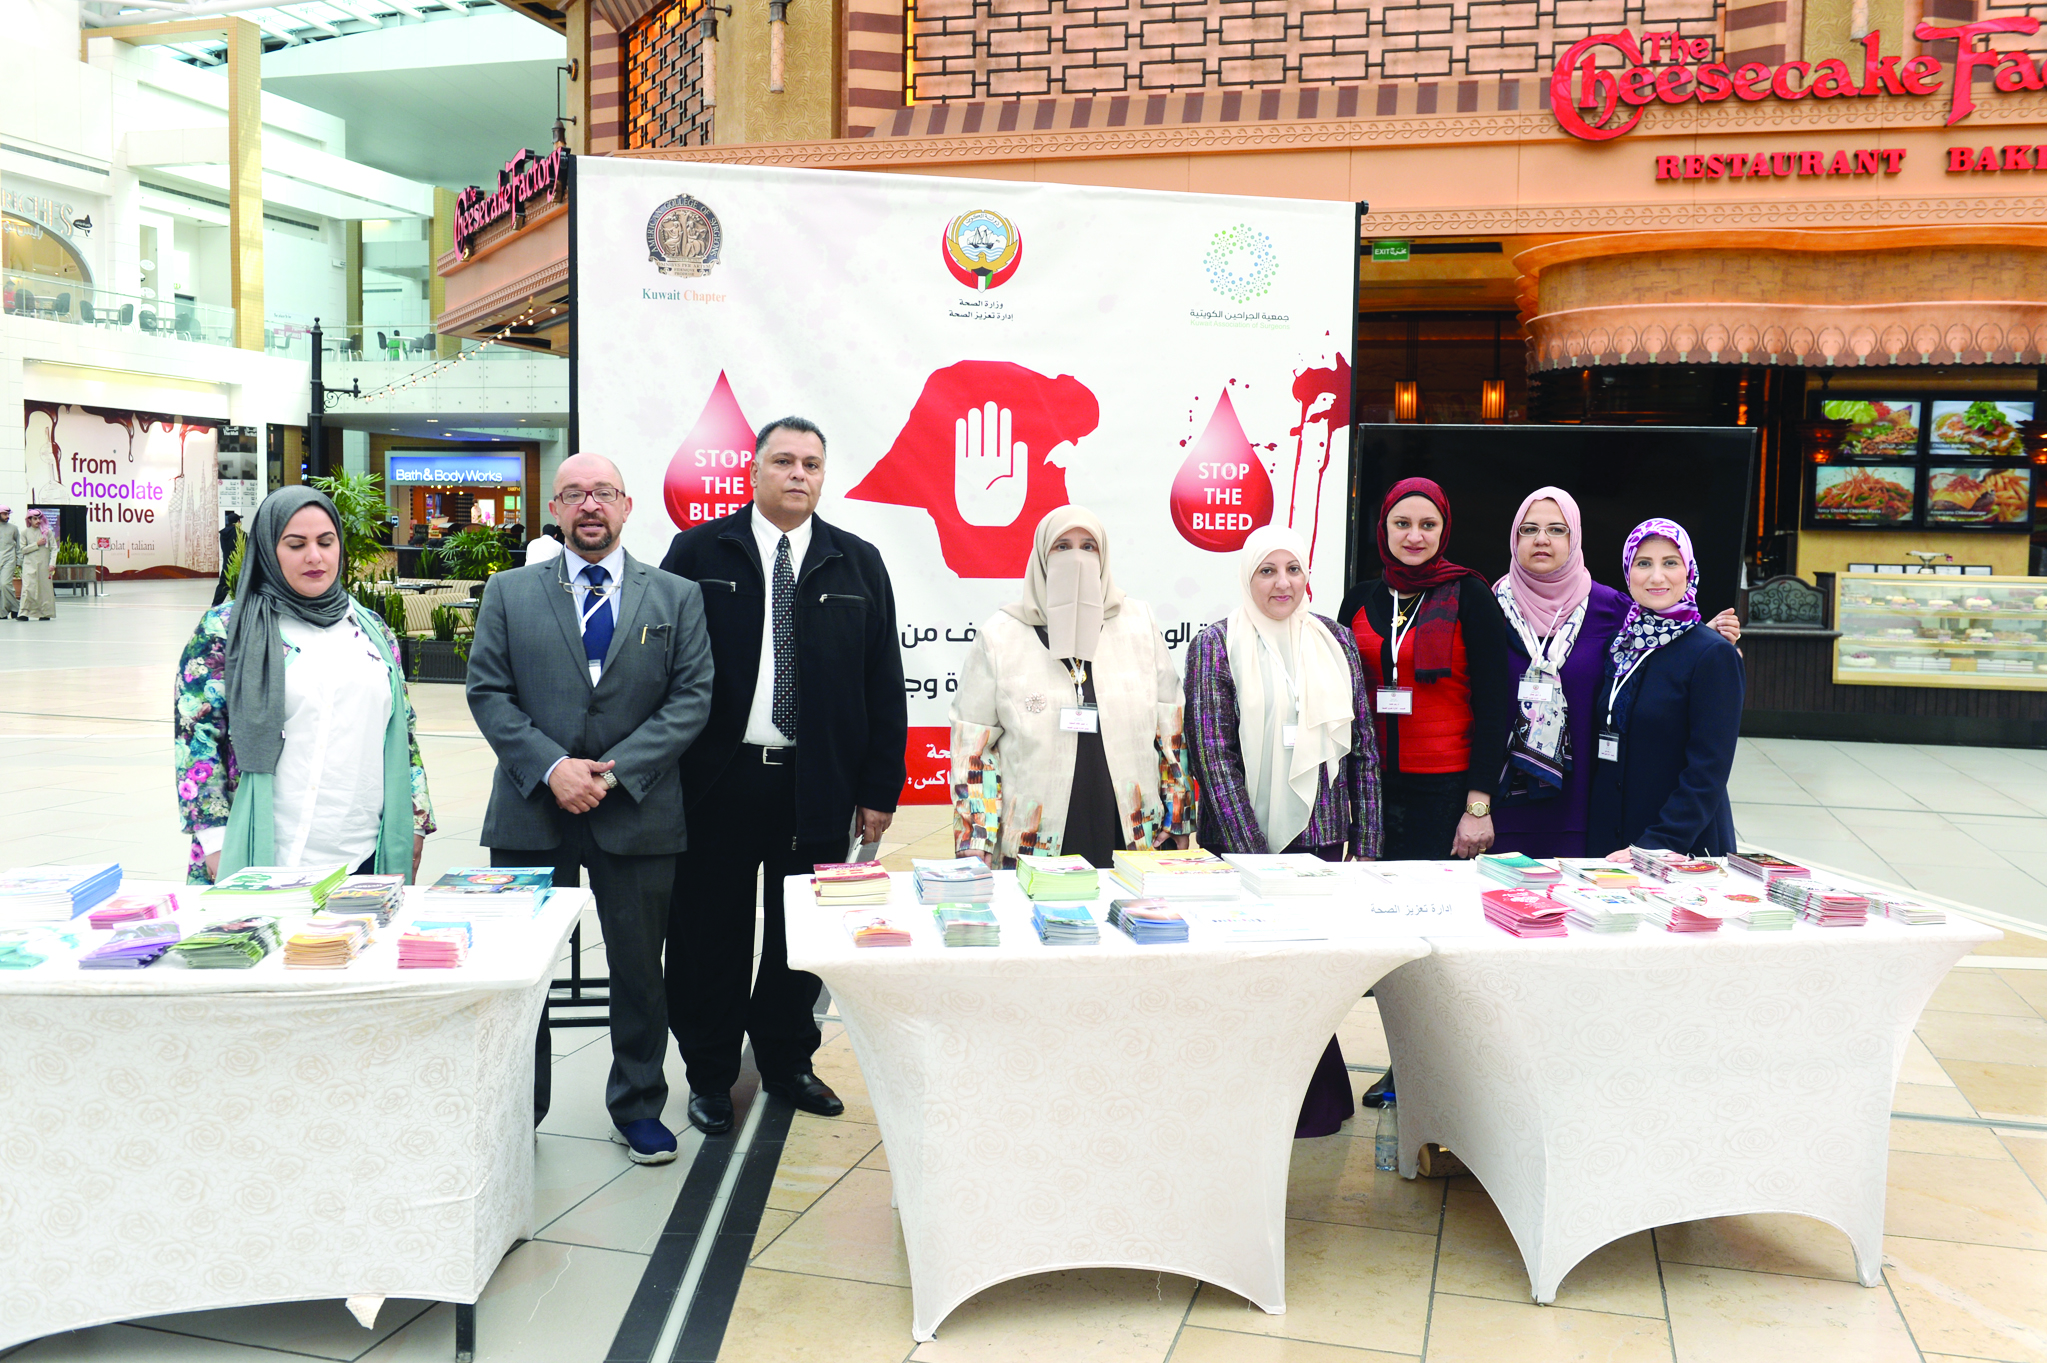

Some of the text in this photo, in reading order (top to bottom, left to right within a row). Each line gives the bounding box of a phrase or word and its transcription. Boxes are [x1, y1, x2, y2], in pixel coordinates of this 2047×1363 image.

[1641, 31, 1710, 65] The
[1550, 16, 2047, 141] Cheesecake Fa
[1656, 148, 1906, 180] RESTAURANT
[453, 147, 562, 261] Cheesecake Factory
[648, 209, 663, 252] AMERICAN
[664, 200, 698, 209] COLLEGE
[700, 206, 710, 215] OF
[642, 288, 726, 304] Kuwait Chapter
[984, 300, 1004, 309] وزارة
[974, 312, 996, 320] تعزيز
[1190, 309, 1290, 322] جمعية الجراحين الكويتية
[71, 452, 116, 474] from
[694, 449, 752, 468] STOP
[396, 468, 502, 483] Bath & Body Works
[1198, 462, 1250, 480] STOP
[71, 477, 163, 500] chocolate
[701, 476, 744, 494] THE
[1204, 488, 1242, 505] THE
[86, 502, 154, 523] ith love
[690, 502, 748, 520] BLEE
[1192, 512, 1253, 530] BLEED
[902, 624, 938, 648] من
[1371, 903, 1400, 913] الصحة
[1405, 904, 1428, 916] تعزيز
